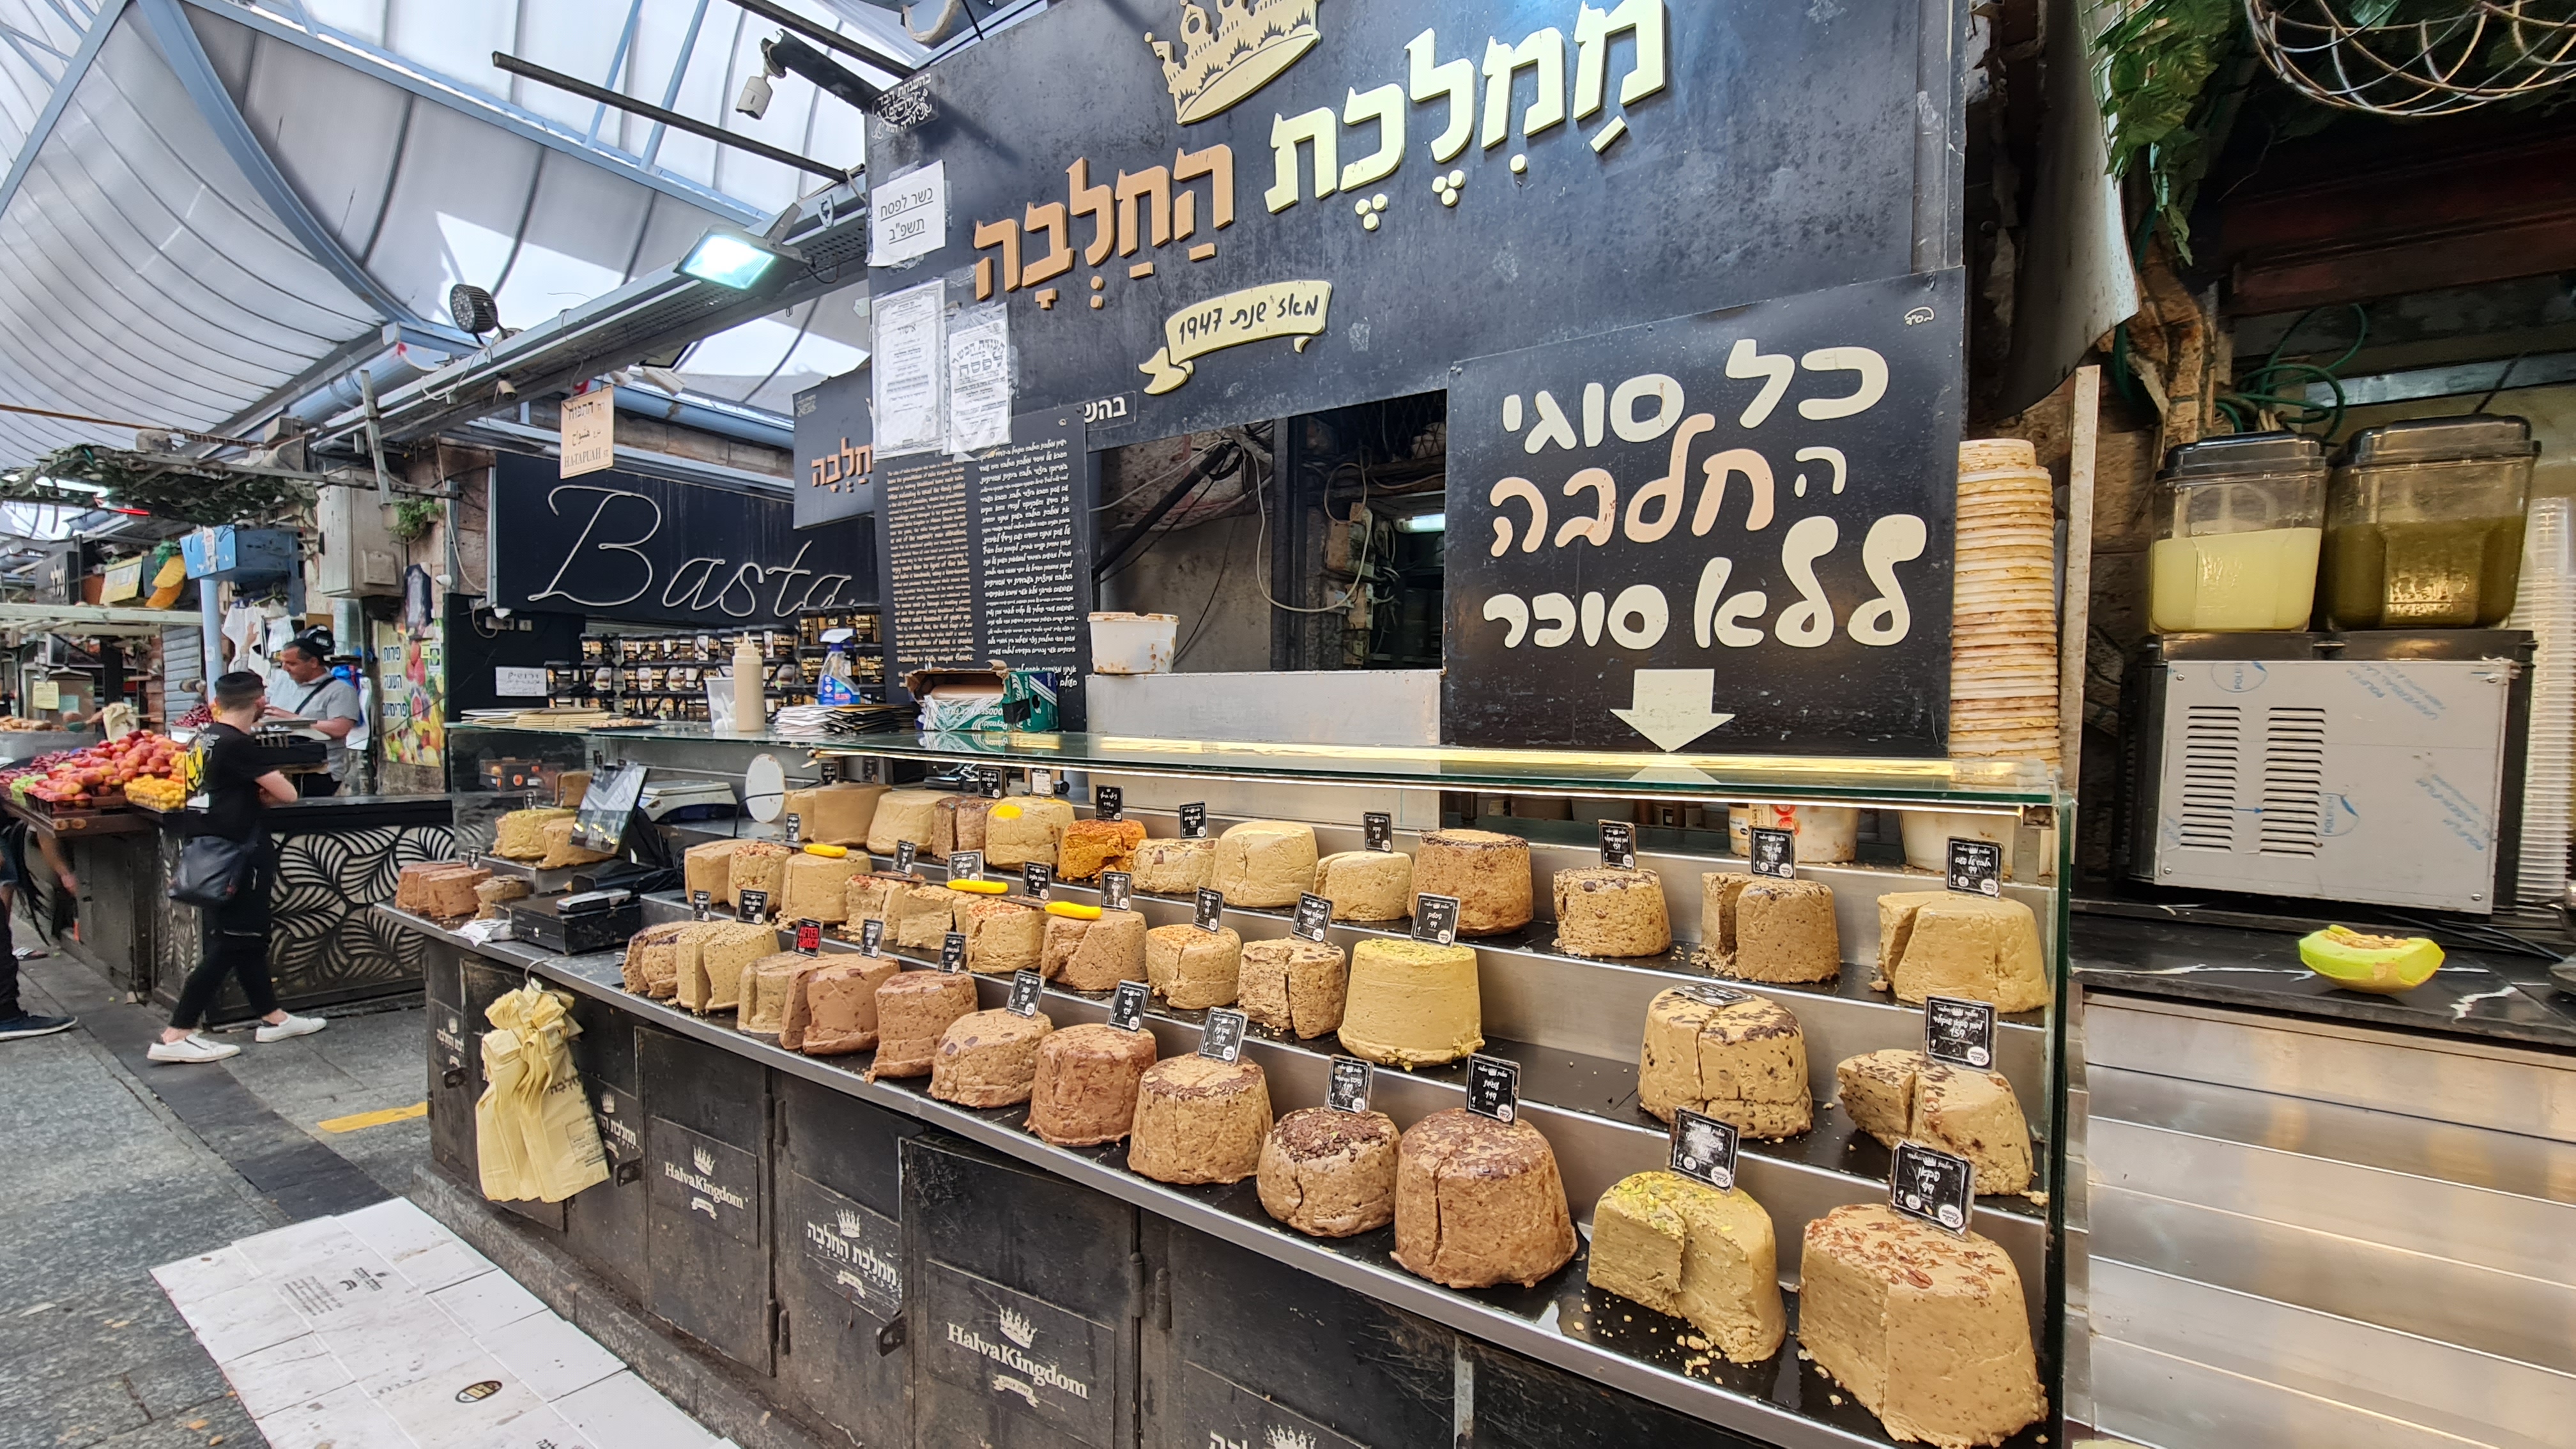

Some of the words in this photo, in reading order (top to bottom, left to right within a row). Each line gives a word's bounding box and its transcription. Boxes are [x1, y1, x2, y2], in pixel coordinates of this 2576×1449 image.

[880, 194, 908, 218] לפסח
[911, 187, 933, 205] כשר
[889, 218, 925, 241] תשפ"ב
[1229, 302, 1267, 330] שנת
[1278, 293, 1319, 318] מאז
[1179, 307, 1223, 346] 1947
[958, 351, 1003, 378] לפסח
[1724, 339, 1889, 429] כל
[1502, 373, 1686, 454] סוגי
[528, 484, 854, 618] Basta
[1694, 514, 1928, 649] ללא
[1482, 583, 1669, 650] סוכר
[384, 645, 401, 663] פירות
[384, 673, 402, 691] העונה
[799, 926, 819, 939] AFTER
[1949, 1028, 1966, 1038] 159
[664, 1161, 744, 1210] HalvaKingdom
[1917, 1166, 1941, 1183] פקאן
[946, 1321, 1089, 1400] HalvaKingdom
